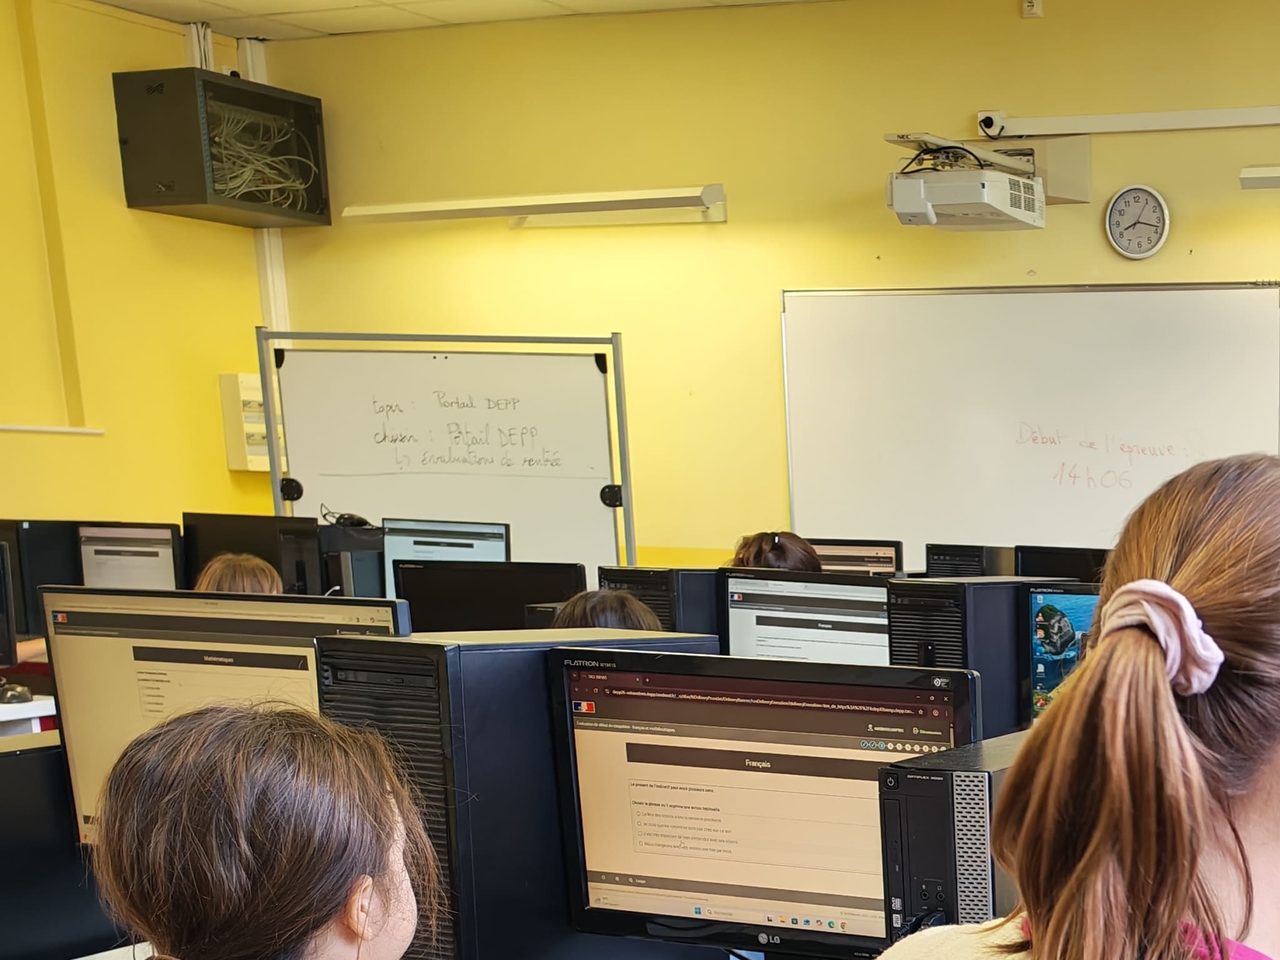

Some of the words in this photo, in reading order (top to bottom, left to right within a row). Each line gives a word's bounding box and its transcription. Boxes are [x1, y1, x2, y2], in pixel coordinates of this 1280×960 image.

[564, 659, 600, 668] FLATRON
[745, 758, 772, 769] Français
[769, 935, 780, 944] LG
